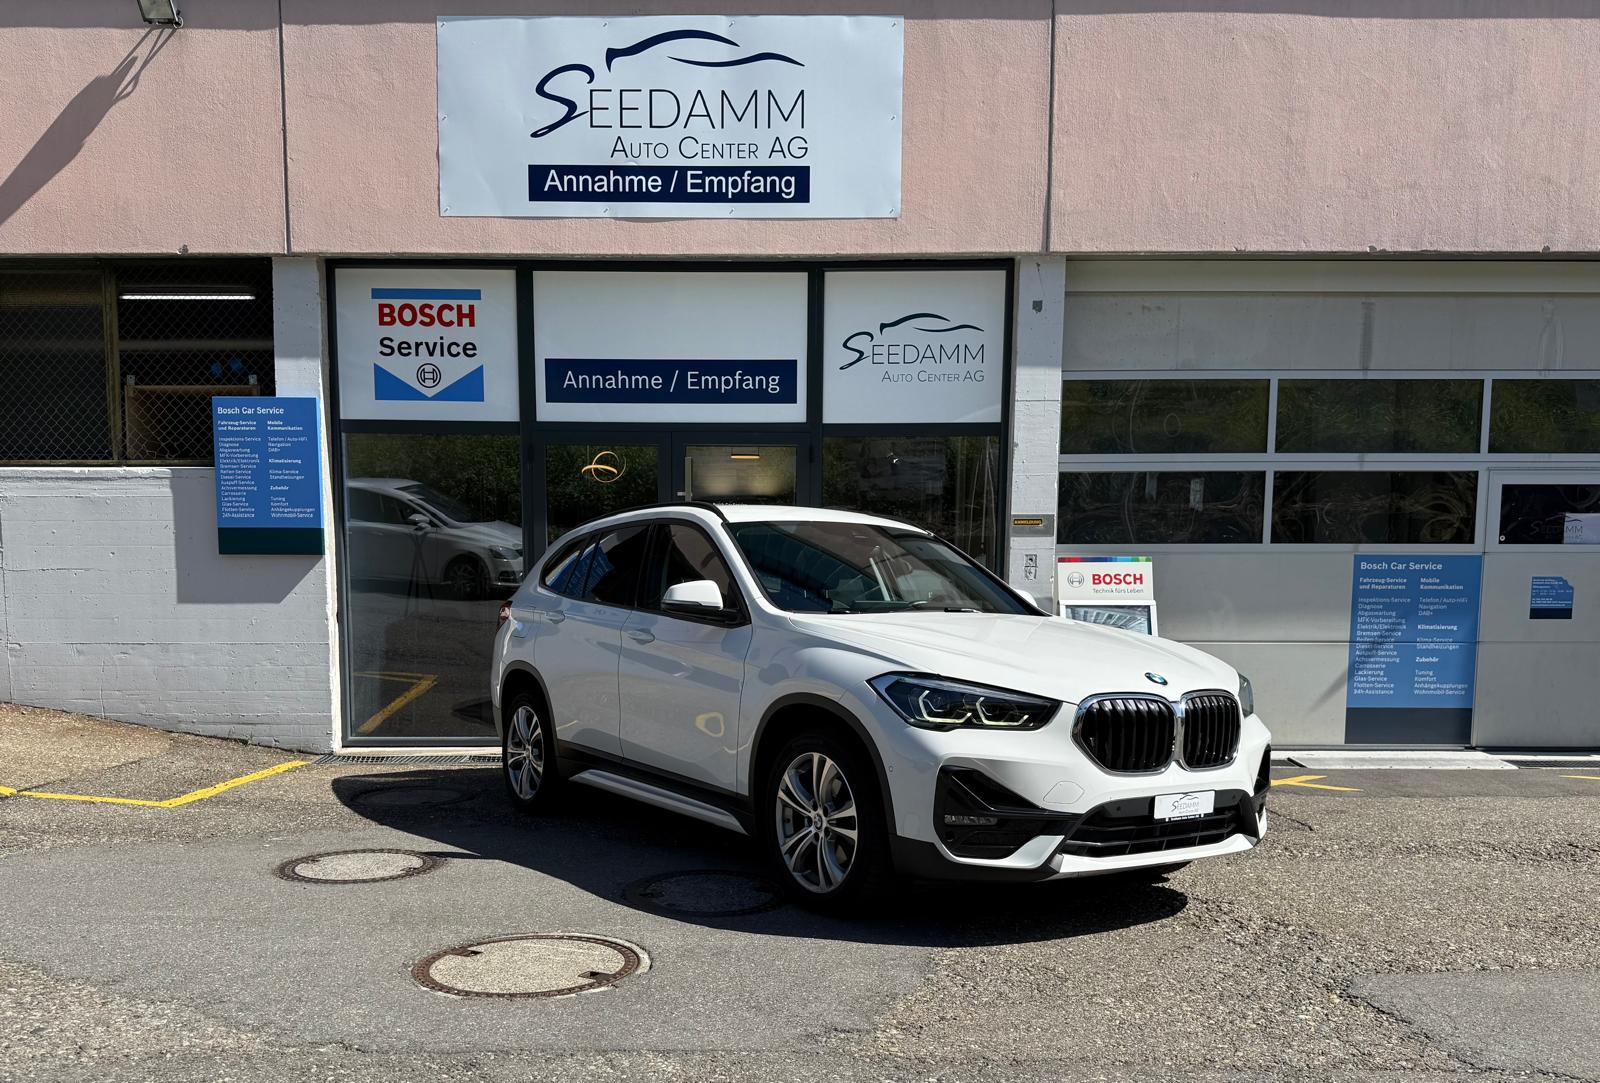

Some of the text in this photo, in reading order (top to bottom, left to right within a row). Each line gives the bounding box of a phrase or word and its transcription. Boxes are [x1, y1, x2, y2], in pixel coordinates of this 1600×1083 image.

[530, 64, 805, 138] SEEDAMM
[769, 136, 808, 159] AG
[544, 170, 796, 199] Annahme / Empfang
[378, 303, 475, 327] BOSCH
[379, 336, 477, 358] Service
[839, 331, 984, 370] SEEDAMM
[563, 370, 780, 393] Annahme / Empfang
[963, 370, 984, 382] AG
[1360, 562, 1442, 570] Bosch Car Service
[1092, 574, 1143, 585] BOSCH
